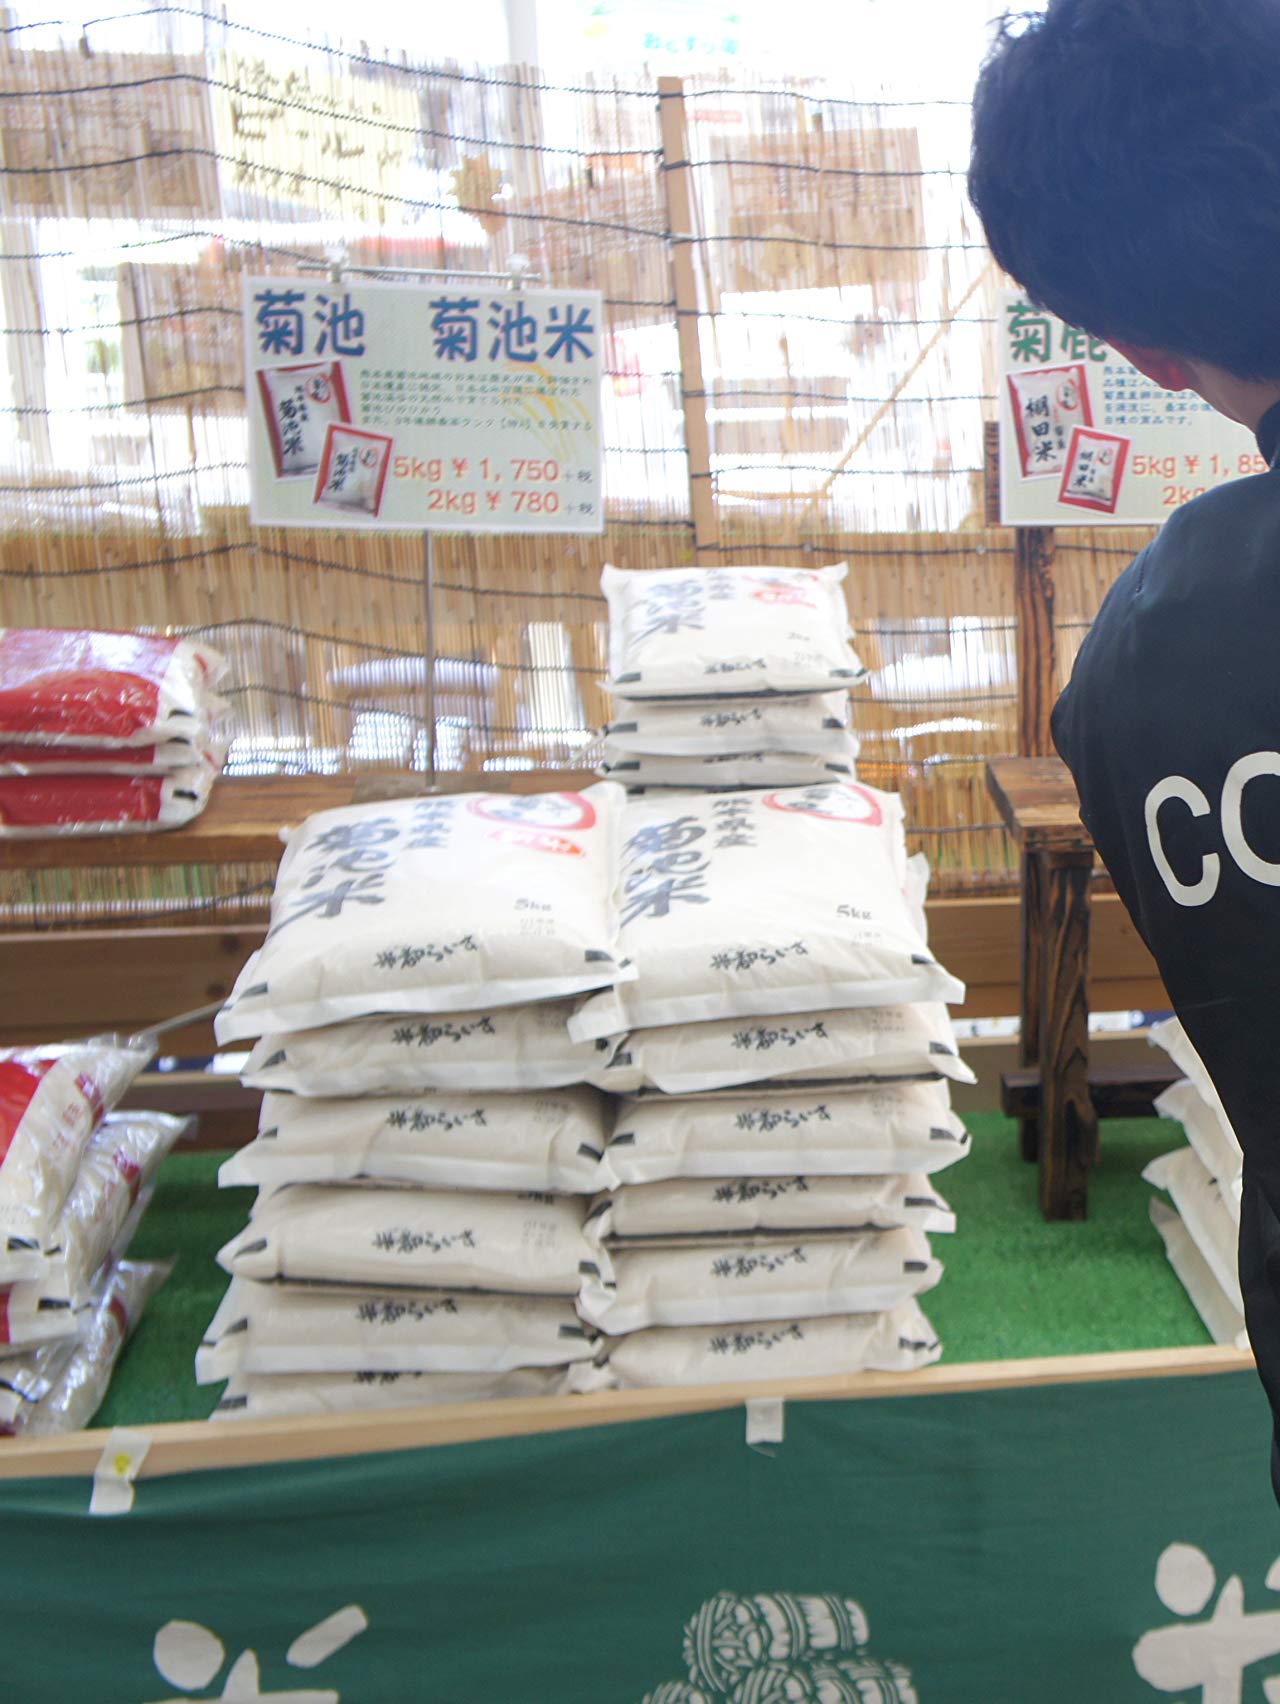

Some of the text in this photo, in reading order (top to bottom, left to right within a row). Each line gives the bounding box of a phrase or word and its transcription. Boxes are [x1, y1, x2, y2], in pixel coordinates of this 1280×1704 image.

[254, 290, 595, 363] 菊池 菊池米
[1184, 454, 1271, 477] ¥1,85
[1162, 485, 1206, 506] 2k
